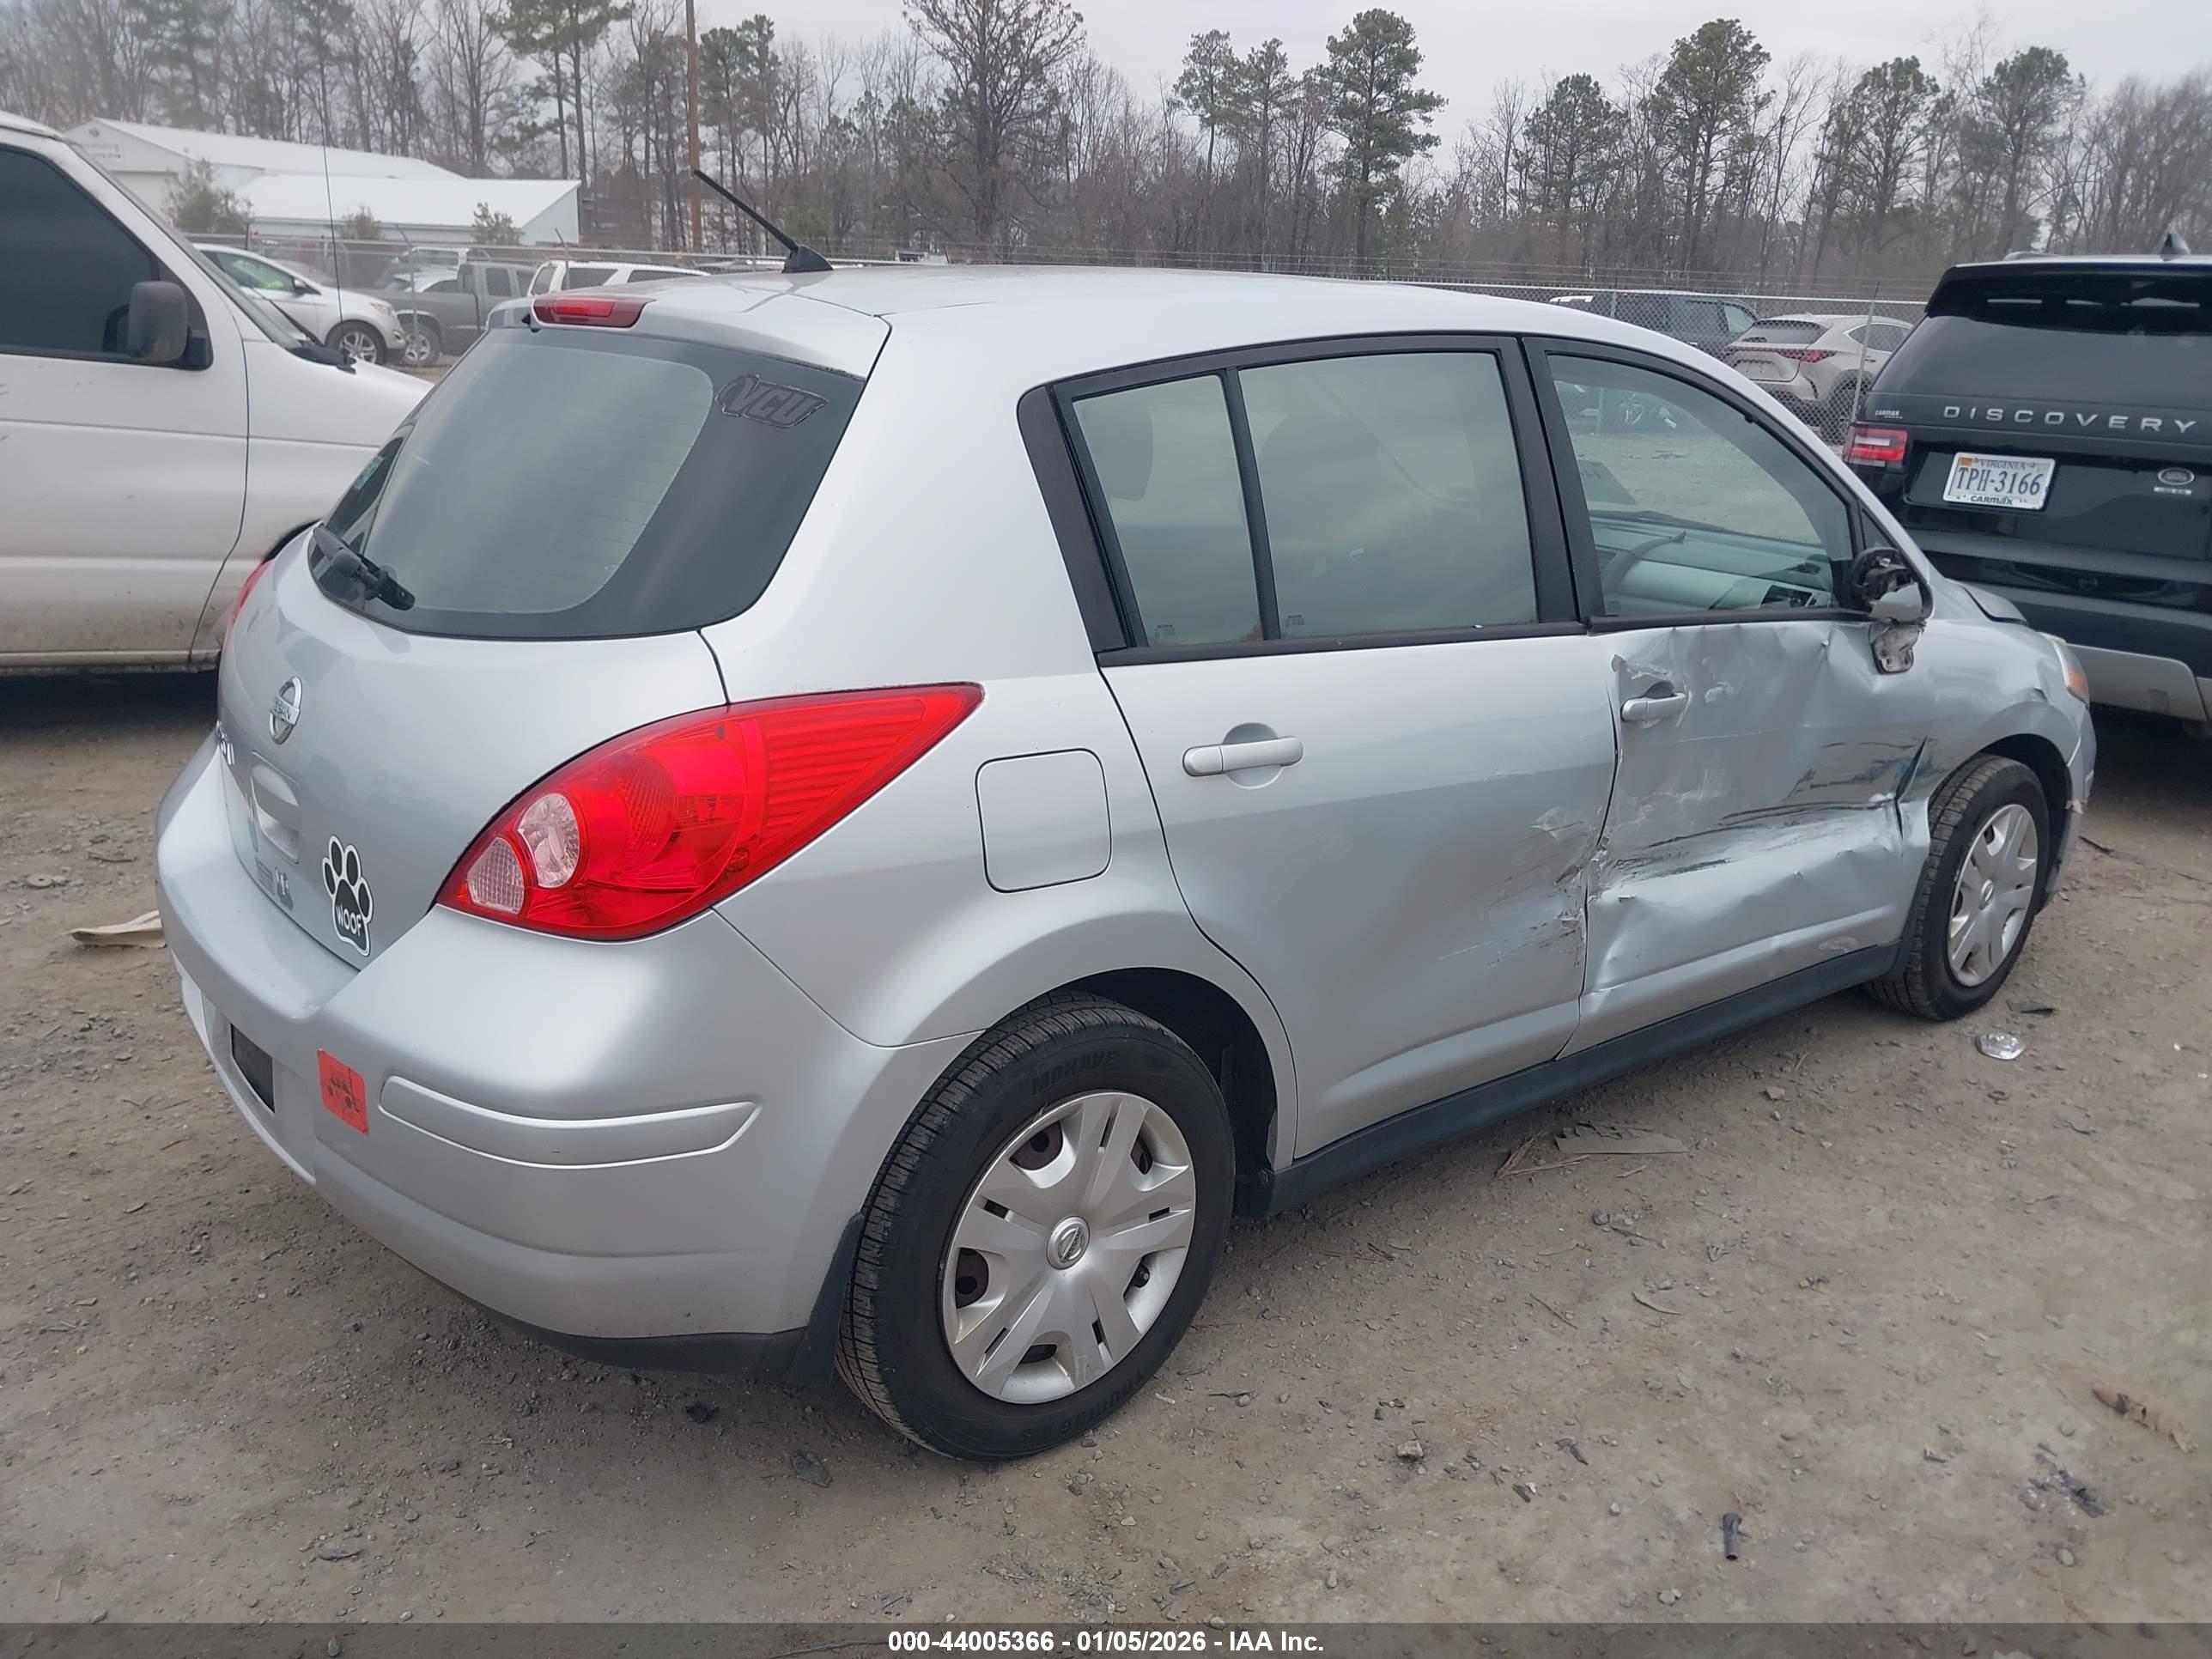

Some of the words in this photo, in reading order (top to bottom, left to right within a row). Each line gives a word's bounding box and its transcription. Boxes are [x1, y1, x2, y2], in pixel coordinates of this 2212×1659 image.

[721, 374, 822, 427] VCU
[1943, 405, 2197, 434] DISCOVERY
[1979, 458, 2026, 471] VIRGINIA
[1956, 466, 2044, 495] TPH-3166
[336, 903, 362, 937] WOOF
